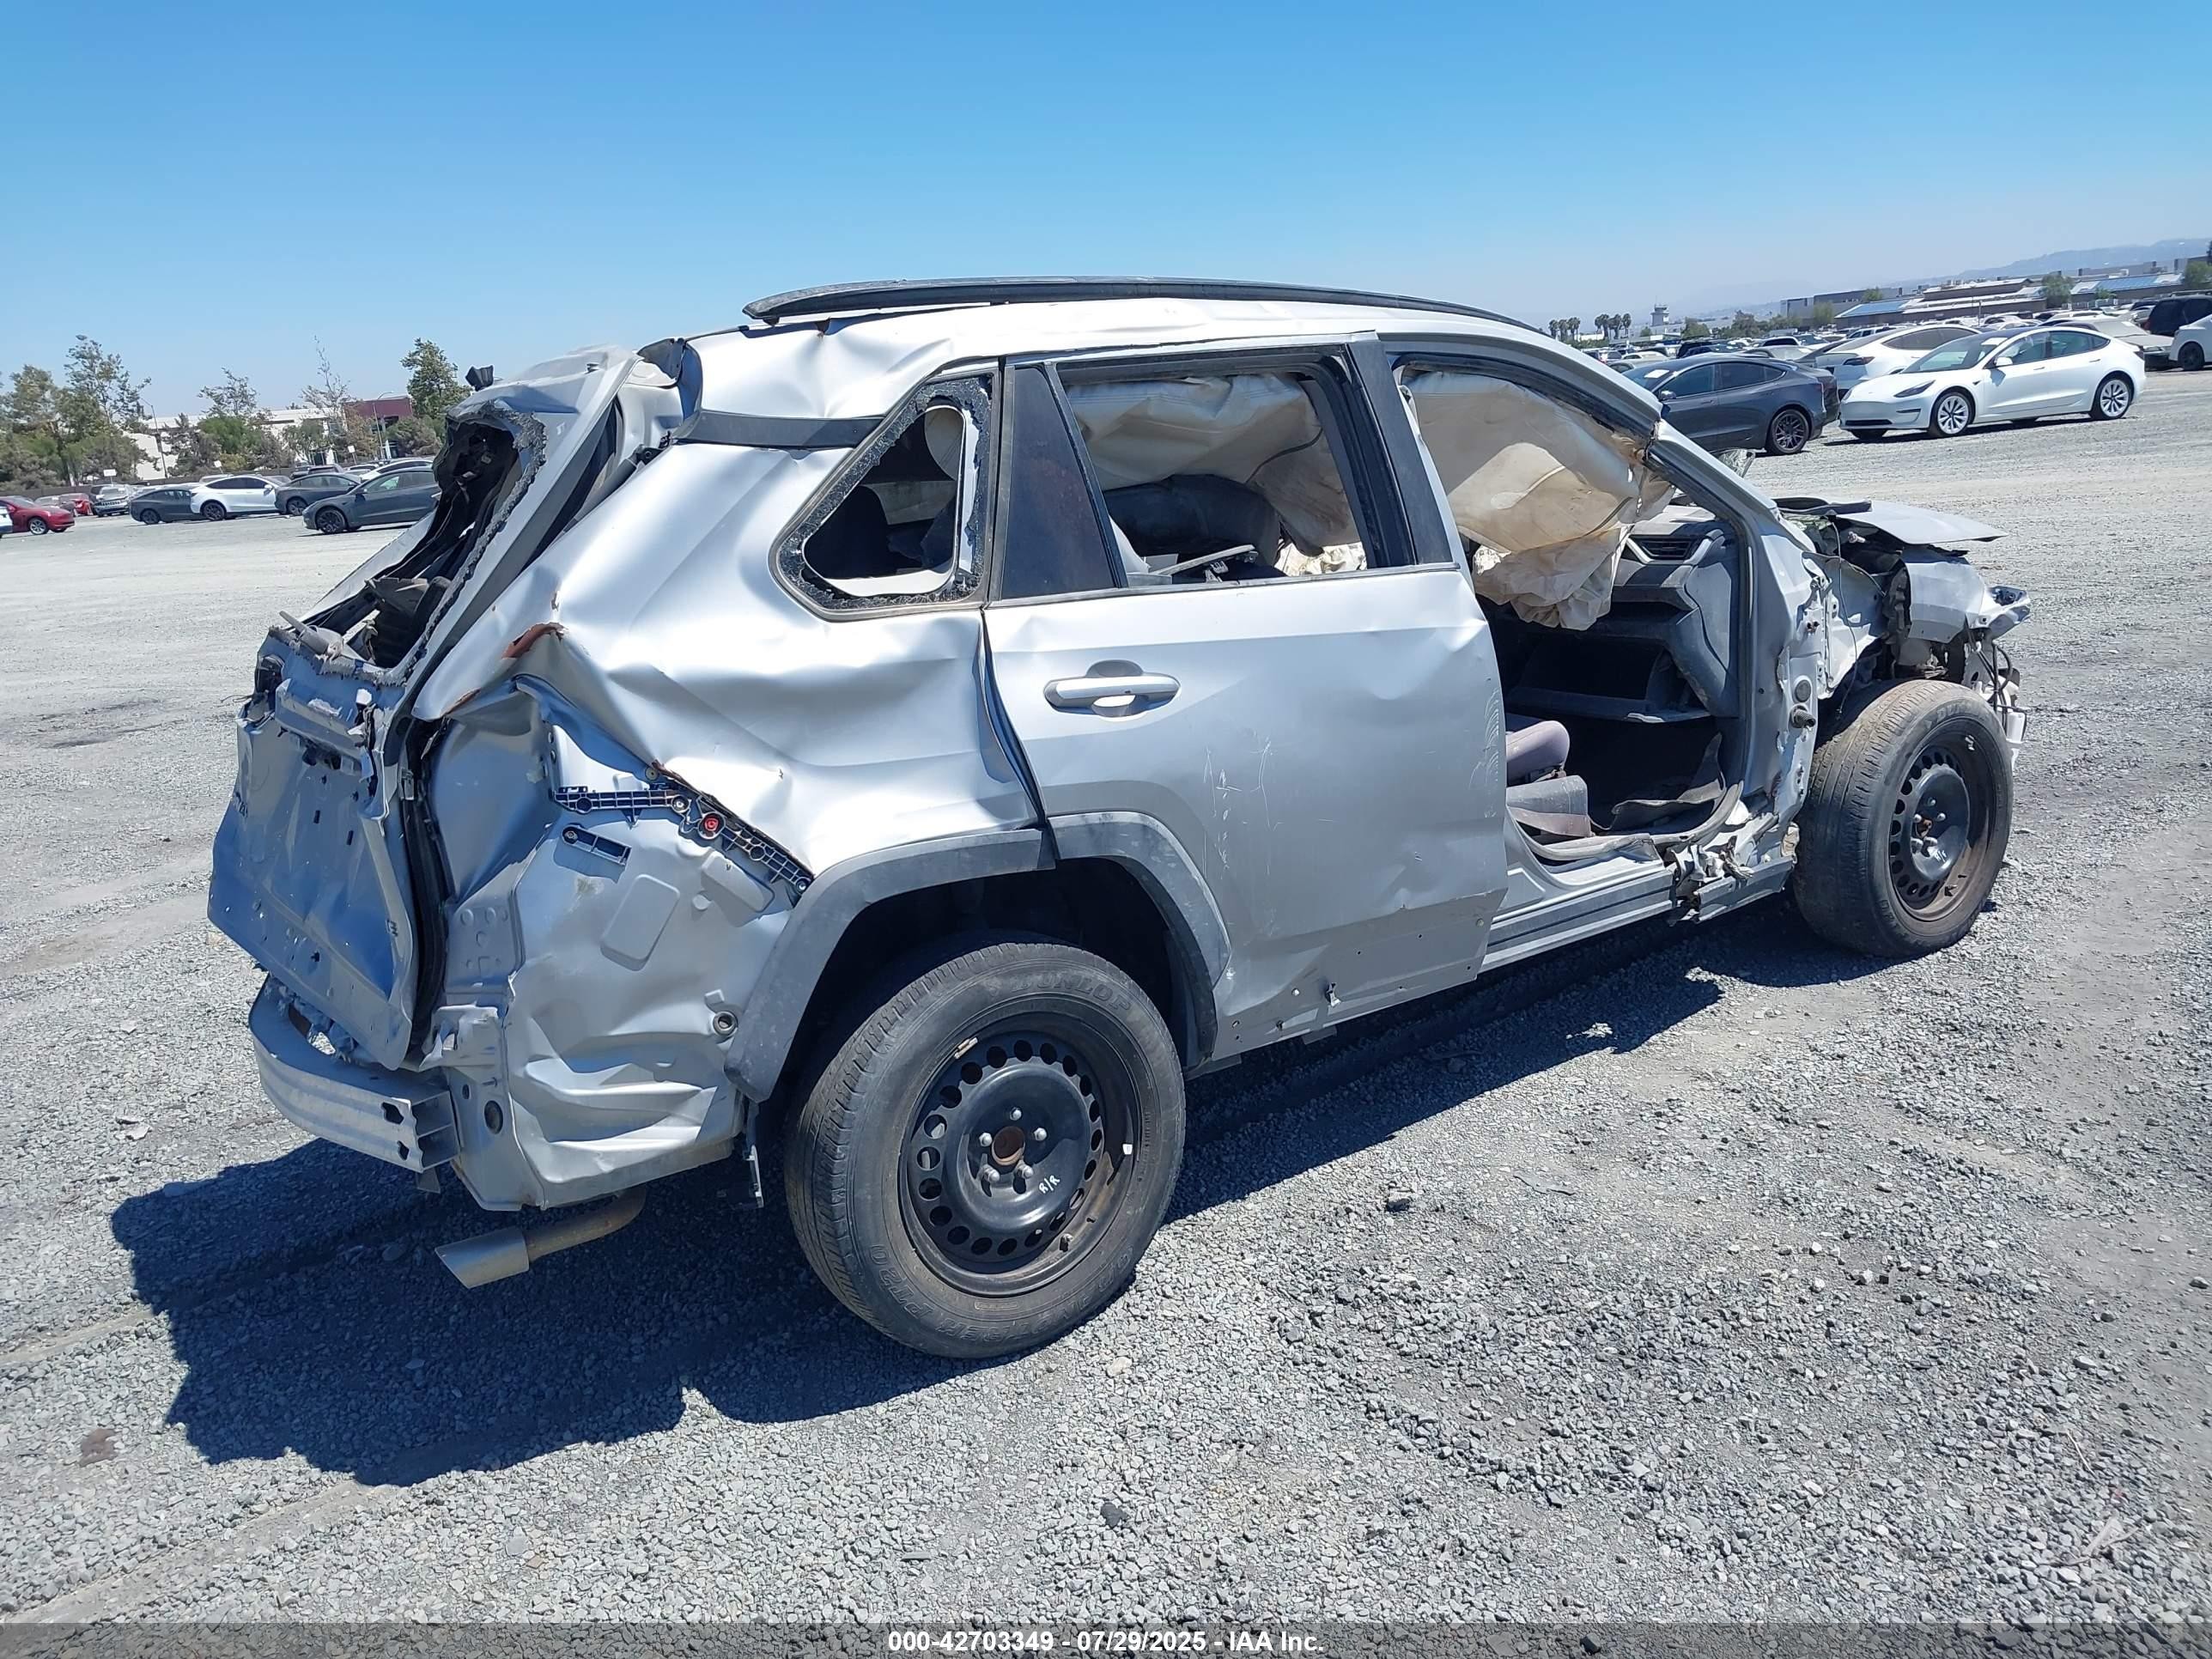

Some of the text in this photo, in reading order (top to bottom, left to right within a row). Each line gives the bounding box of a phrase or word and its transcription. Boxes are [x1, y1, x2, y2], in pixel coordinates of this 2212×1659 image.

[1011, 970, 1133, 1012] DUNLOP
[1038, 1175, 1060, 1194] R/R
[868, 1244, 935, 1320] PT20
